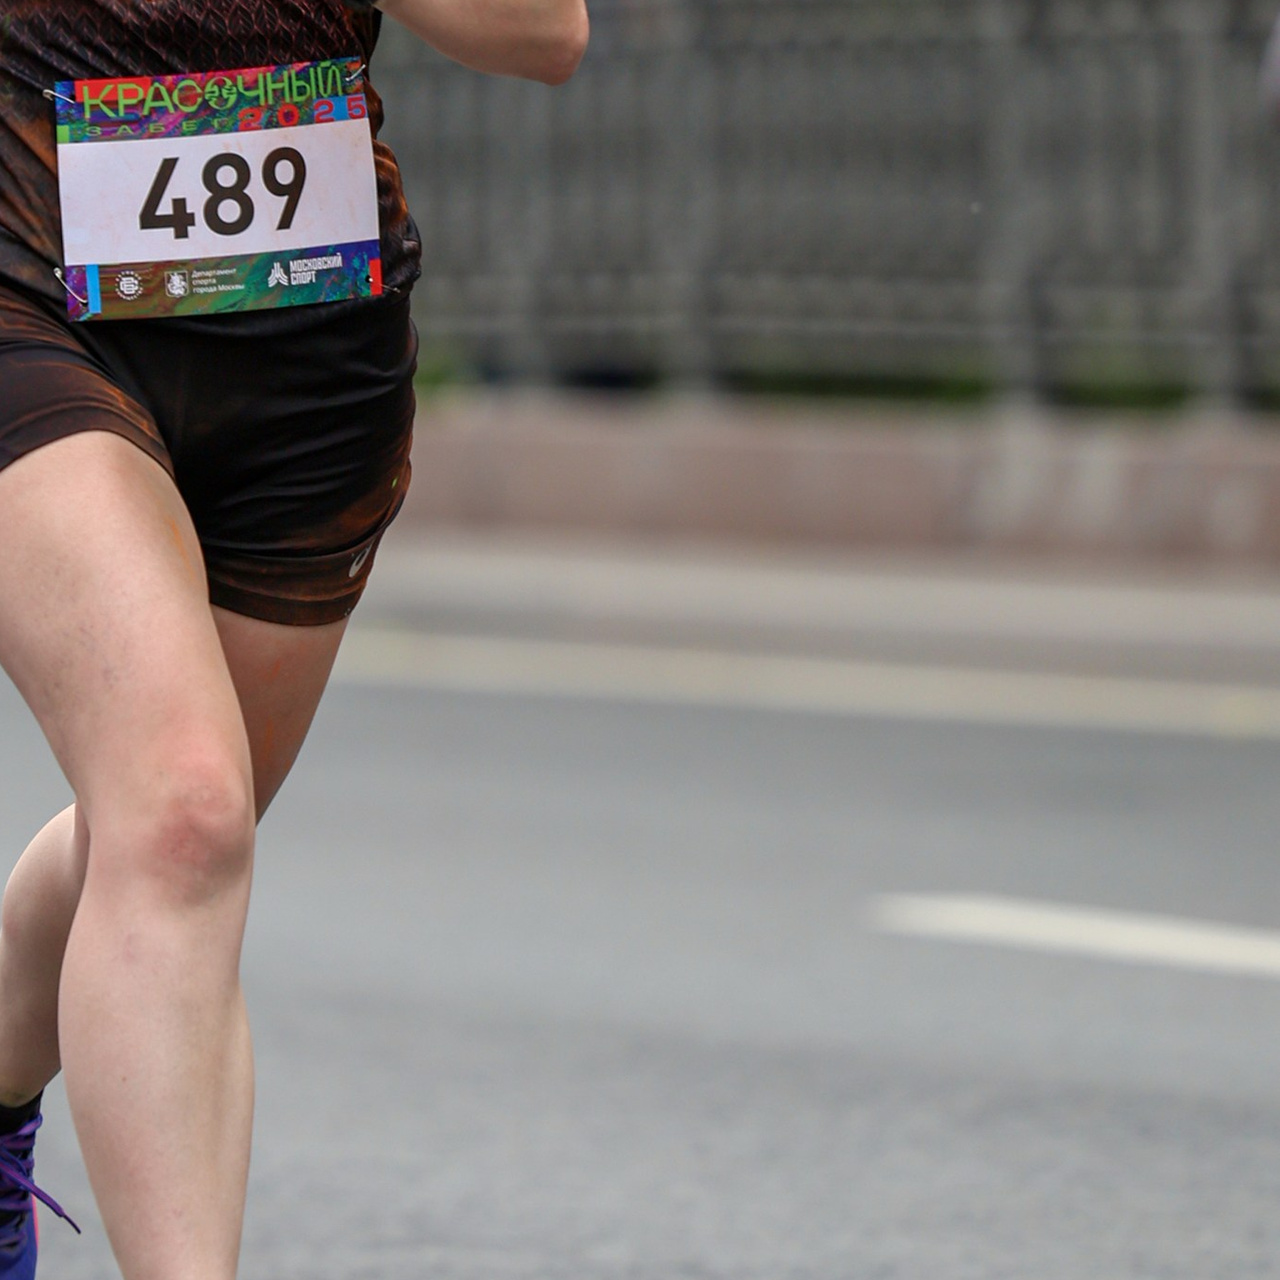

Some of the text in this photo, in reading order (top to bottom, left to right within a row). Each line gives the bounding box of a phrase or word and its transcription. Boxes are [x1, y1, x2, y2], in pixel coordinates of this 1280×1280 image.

[82, 61, 342, 119] КРАСОЧНЫЙ
[85, 95, 367, 136] ЗАБЕГ 2025
[140, 147, 307, 239] 489
[289, 252, 343, 272] МОСКОВСКИЙ
[191, 268, 237, 279] Департамент
[192, 278, 216, 286] спорта
[290, 271, 316, 285] СПОРТ
[192, 283, 245, 294] города Москвы
